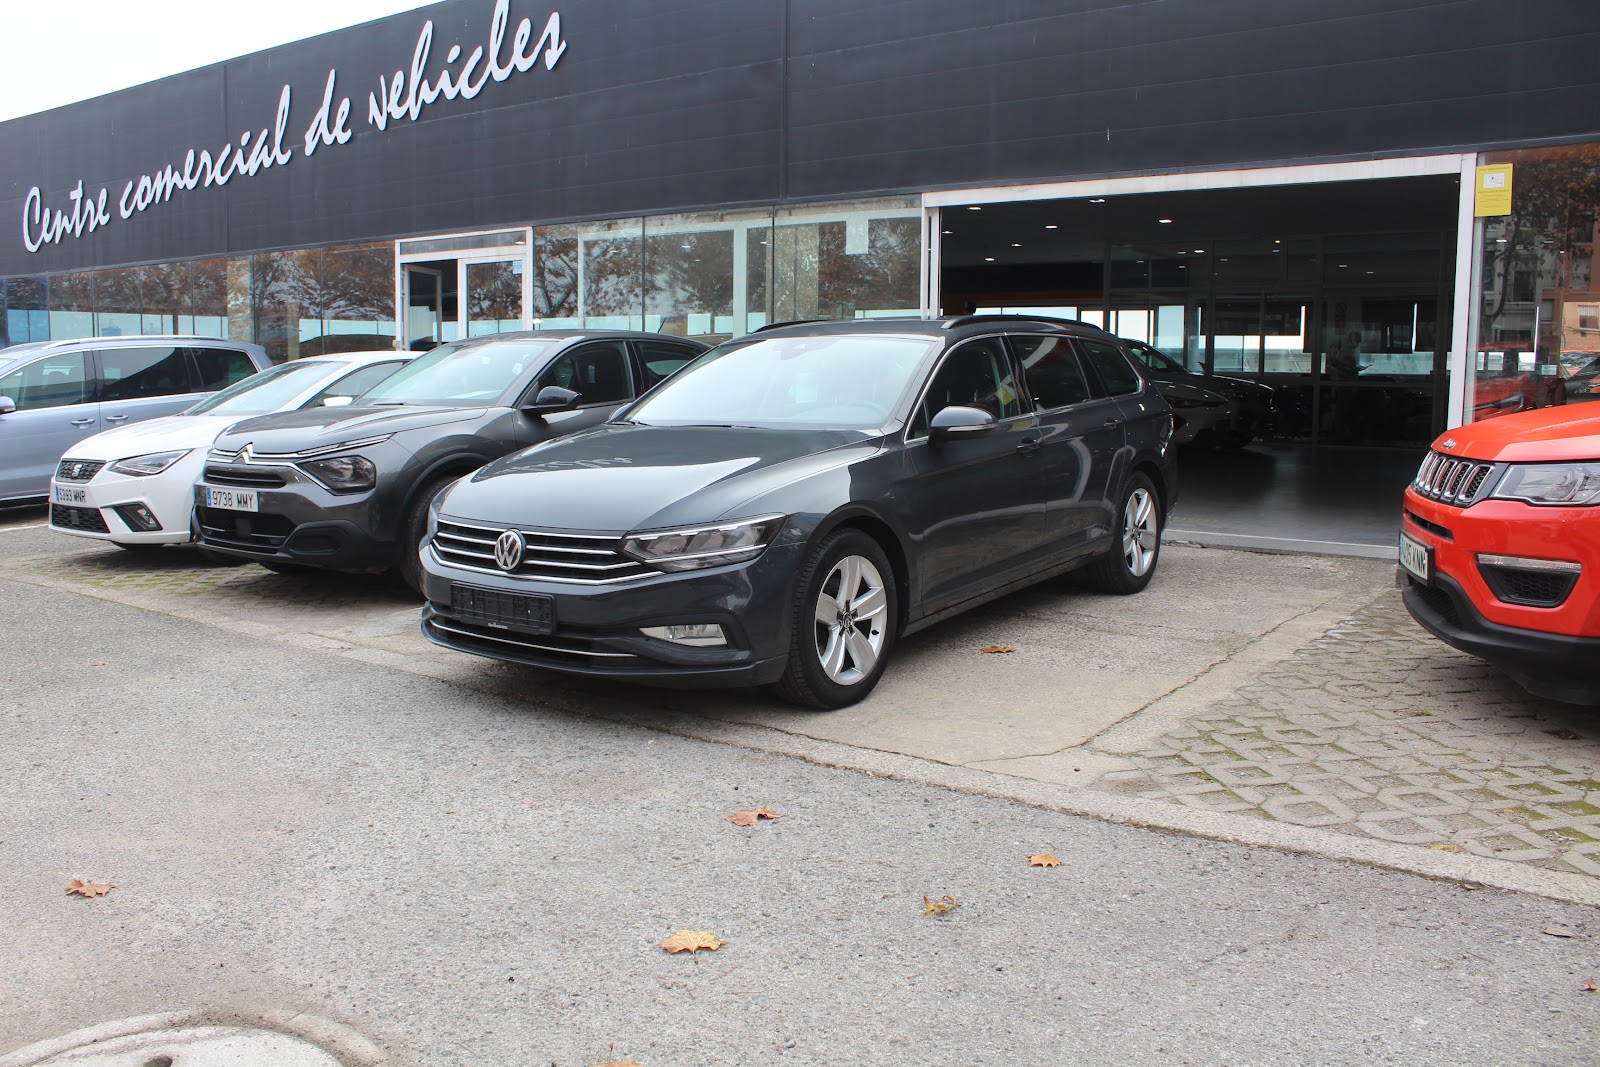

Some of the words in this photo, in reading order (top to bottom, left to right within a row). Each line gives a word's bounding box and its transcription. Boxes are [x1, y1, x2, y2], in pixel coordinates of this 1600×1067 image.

[22, 179, 110, 253] Centre
[119, 84, 292, 220] comercial
[304, 68, 352, 157] de
[368, 0, 567, 131] vehicles
[212, 490, 234, 507] 9738
[236, 492, 254, 509] MMY
